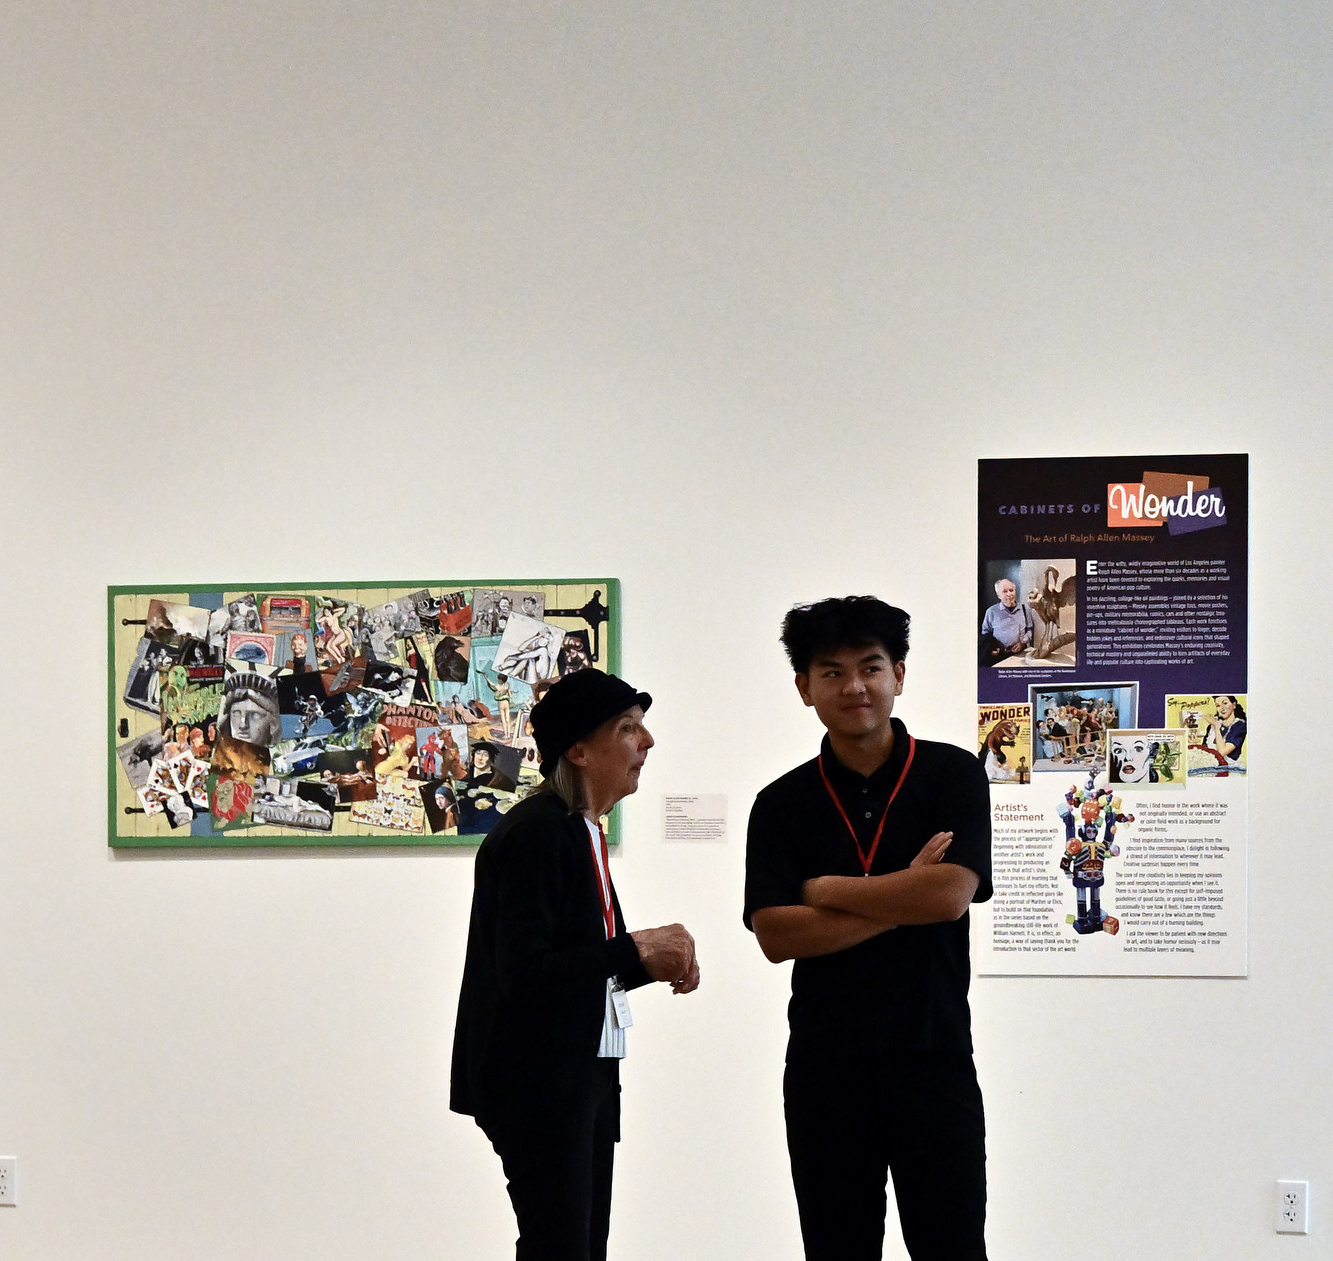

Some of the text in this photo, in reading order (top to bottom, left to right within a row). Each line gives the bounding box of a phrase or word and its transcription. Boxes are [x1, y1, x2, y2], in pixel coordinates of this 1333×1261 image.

[998, 481, 1226, 519] CABINETS OF Wonder
[1025, 533, 1155, 544] The Art of Ralph Allen Massey
[980, 706, 1031, 721] WONDER
[994, 803, 1029, 812] Artist's
[993, 813, 1045, 822] Statement
